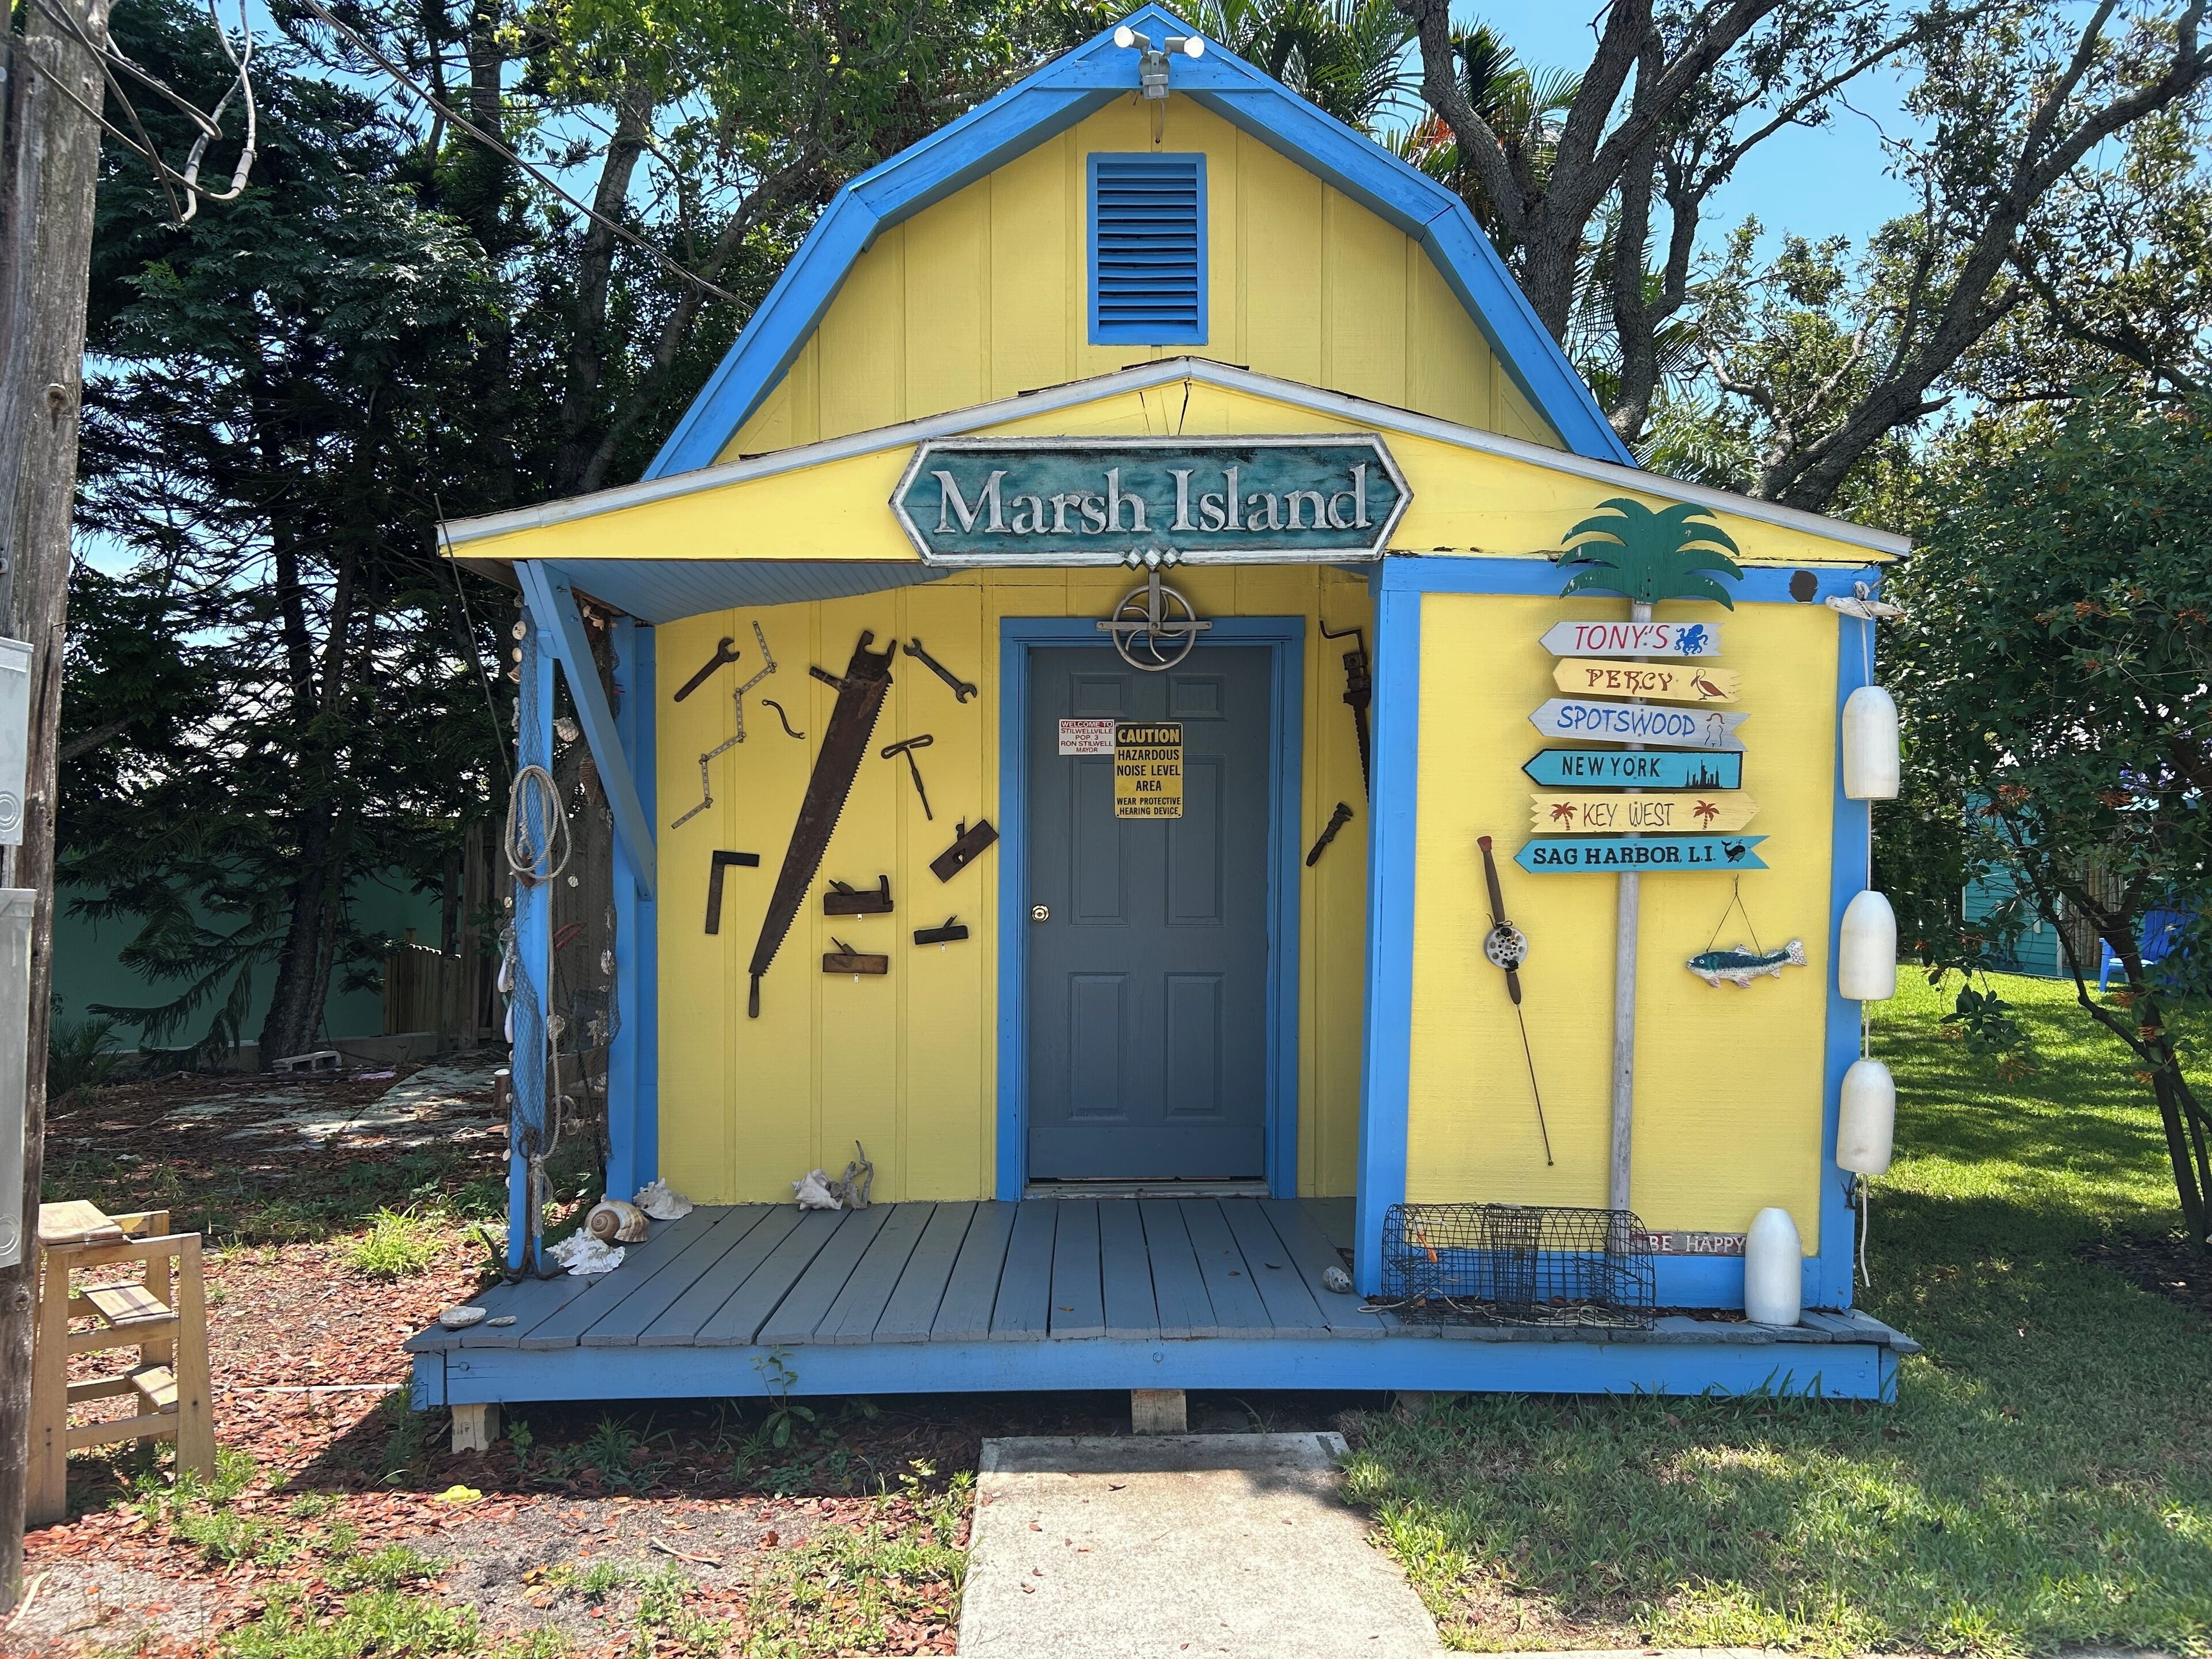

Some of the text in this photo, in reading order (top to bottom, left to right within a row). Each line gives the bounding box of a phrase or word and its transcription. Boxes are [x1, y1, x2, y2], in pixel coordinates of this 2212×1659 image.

[930, 463, 1373, 535] Marsh Island
[1575, 625, 1670, 650] TONY'S
[1586, 668, 1673, 695] PERCY
[1557, 705, 1695, 736] SPOTSWOOD
[1118, 729, 1180, 743] CAUTION
[1118, 749, 1179, 760] HAZARDOUS
[1117, 765, 1180, 776] NOISE LEVEL
[1562, 756, 1661, 778] NEW YORK
[1136, 781, 1161, 791] AREA
[1140, 797, 1181, 805] PROTECTIVE
[1119, 807, 1178, 815] HEARING DEVICE
[1584, 802, 1675, 827] KEY WEST
[1533, 846, 1717, 864] SAG HARBOR, L.I.
[1647, 1235, 1745, 1253] BE HAPPY
